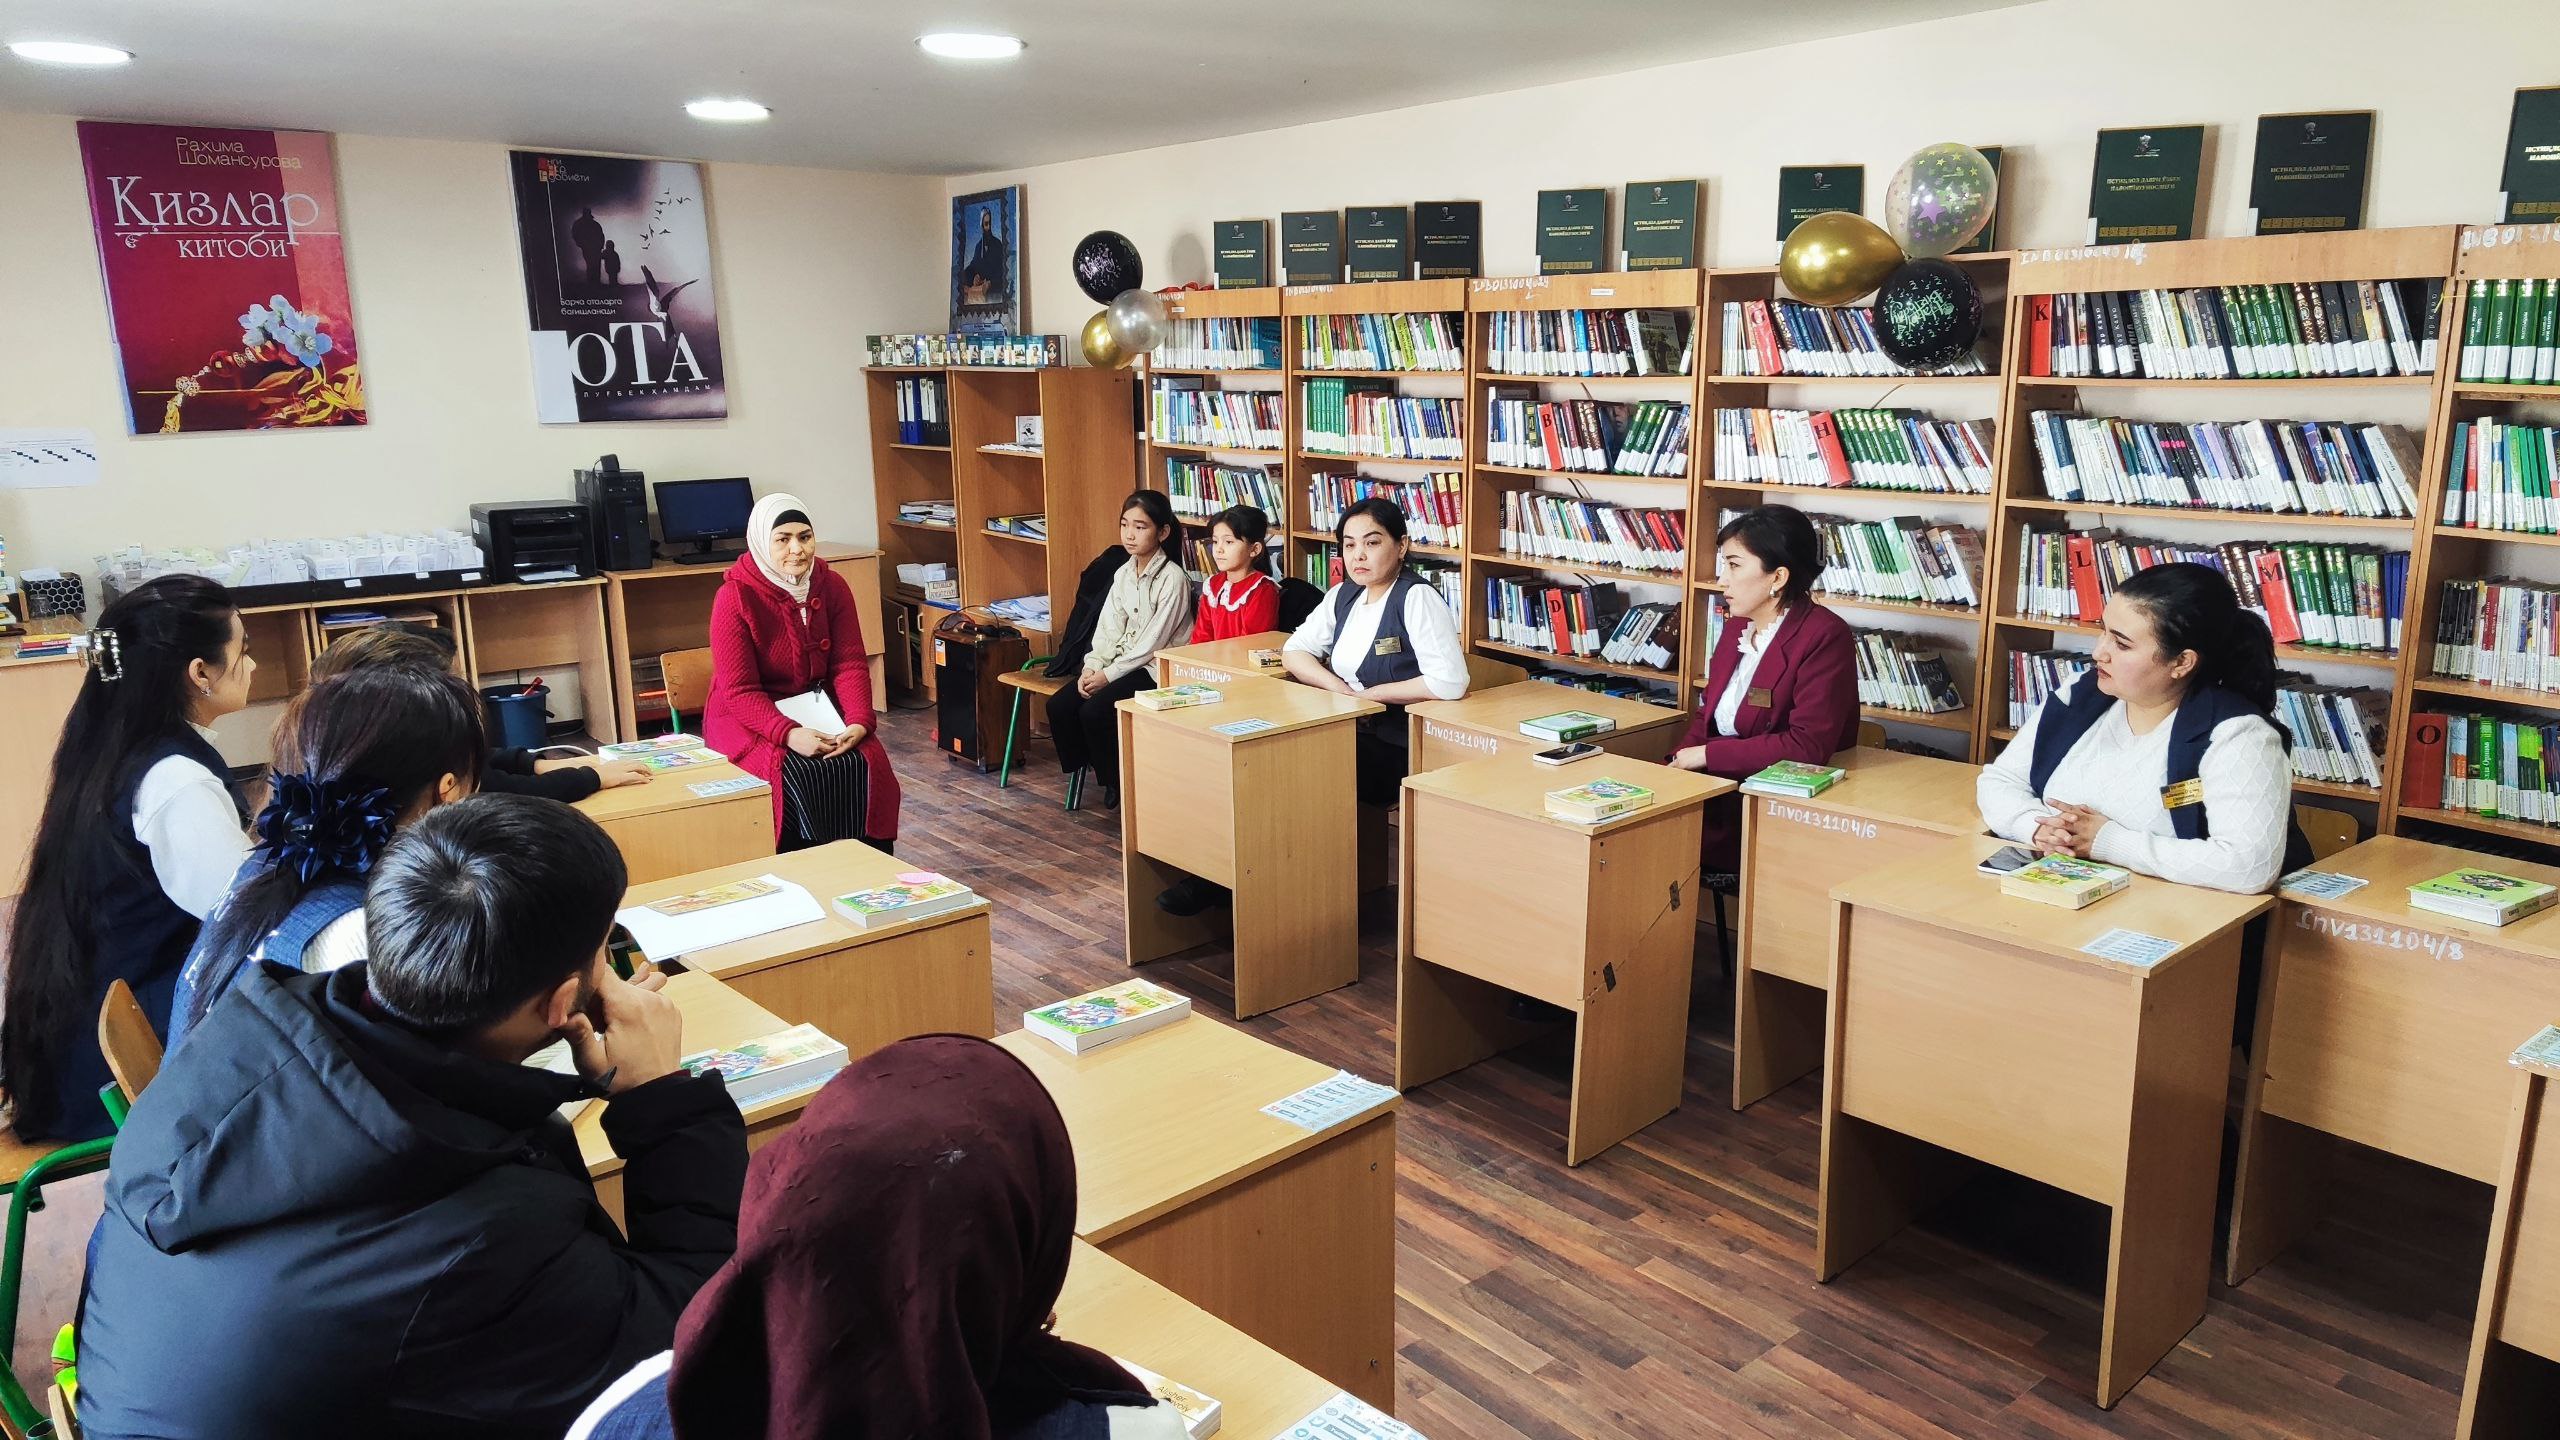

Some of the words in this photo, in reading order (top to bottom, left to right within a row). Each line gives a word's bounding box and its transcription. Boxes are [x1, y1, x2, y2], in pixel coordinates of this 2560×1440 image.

[178, 150, 302, 169] Шомансурова
[107, 175, 319, 246] Қизлар
[176, 230, 288, 258] китоби
[2035, 303, 2049, 322] K
[568, 321, 709, 387] ОТА
[1542, 413, 1552, 428] B
[1813, 422, 1831, 439] H
[2075, 549, 2092, 569] L
[2257, 561, 2284, 585] M
[1550, 599, 1562, 614] D
[2416, 724, 2441, 745] O
